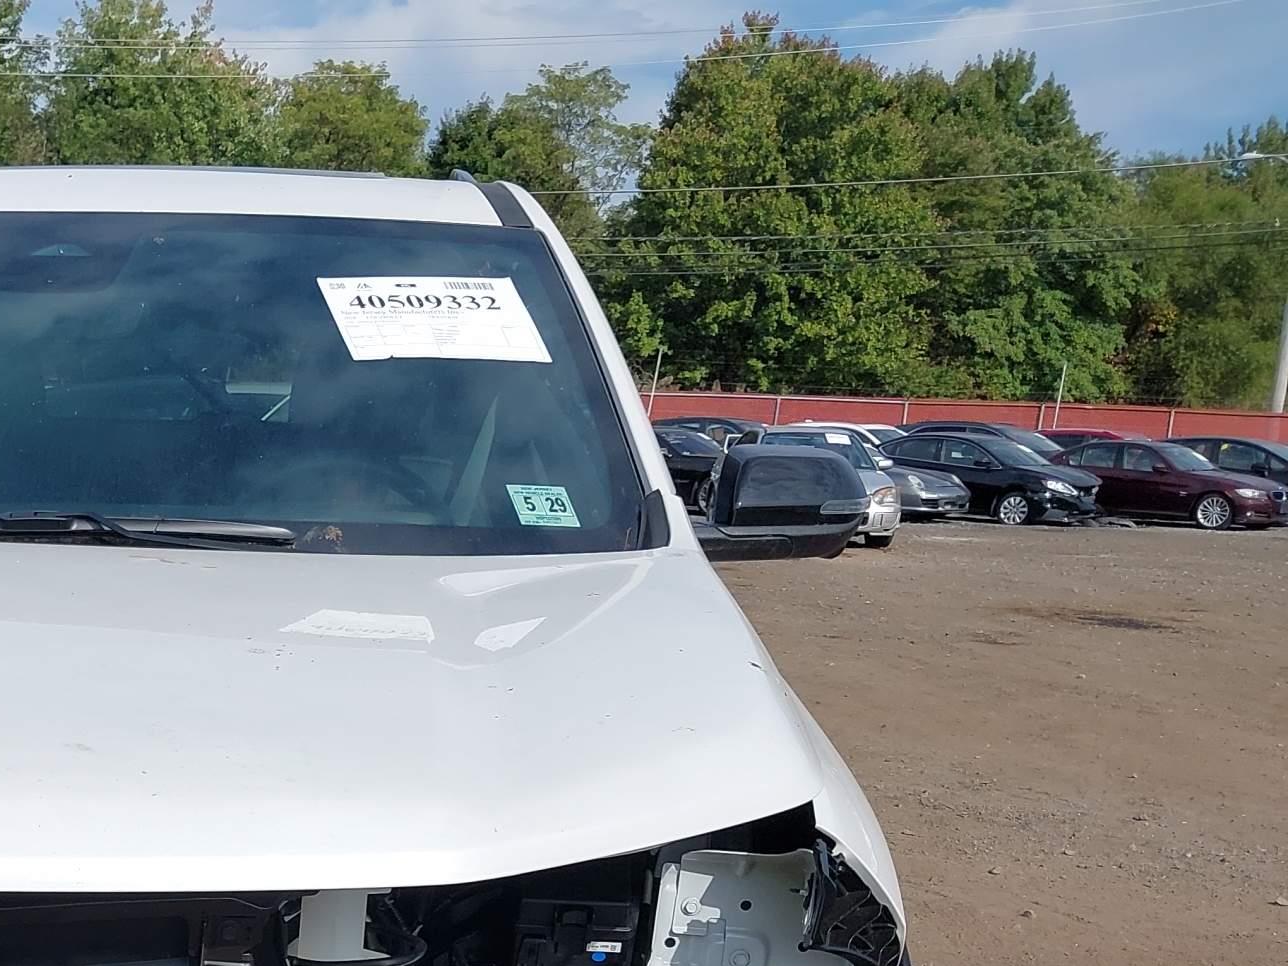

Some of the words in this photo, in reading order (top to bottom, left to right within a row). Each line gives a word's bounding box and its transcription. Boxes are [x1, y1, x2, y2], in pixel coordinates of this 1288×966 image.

[349, 294, 501, 310] 40509332
[523, 496, 536, 512] 5
[545, 497, 567, 513] 29
